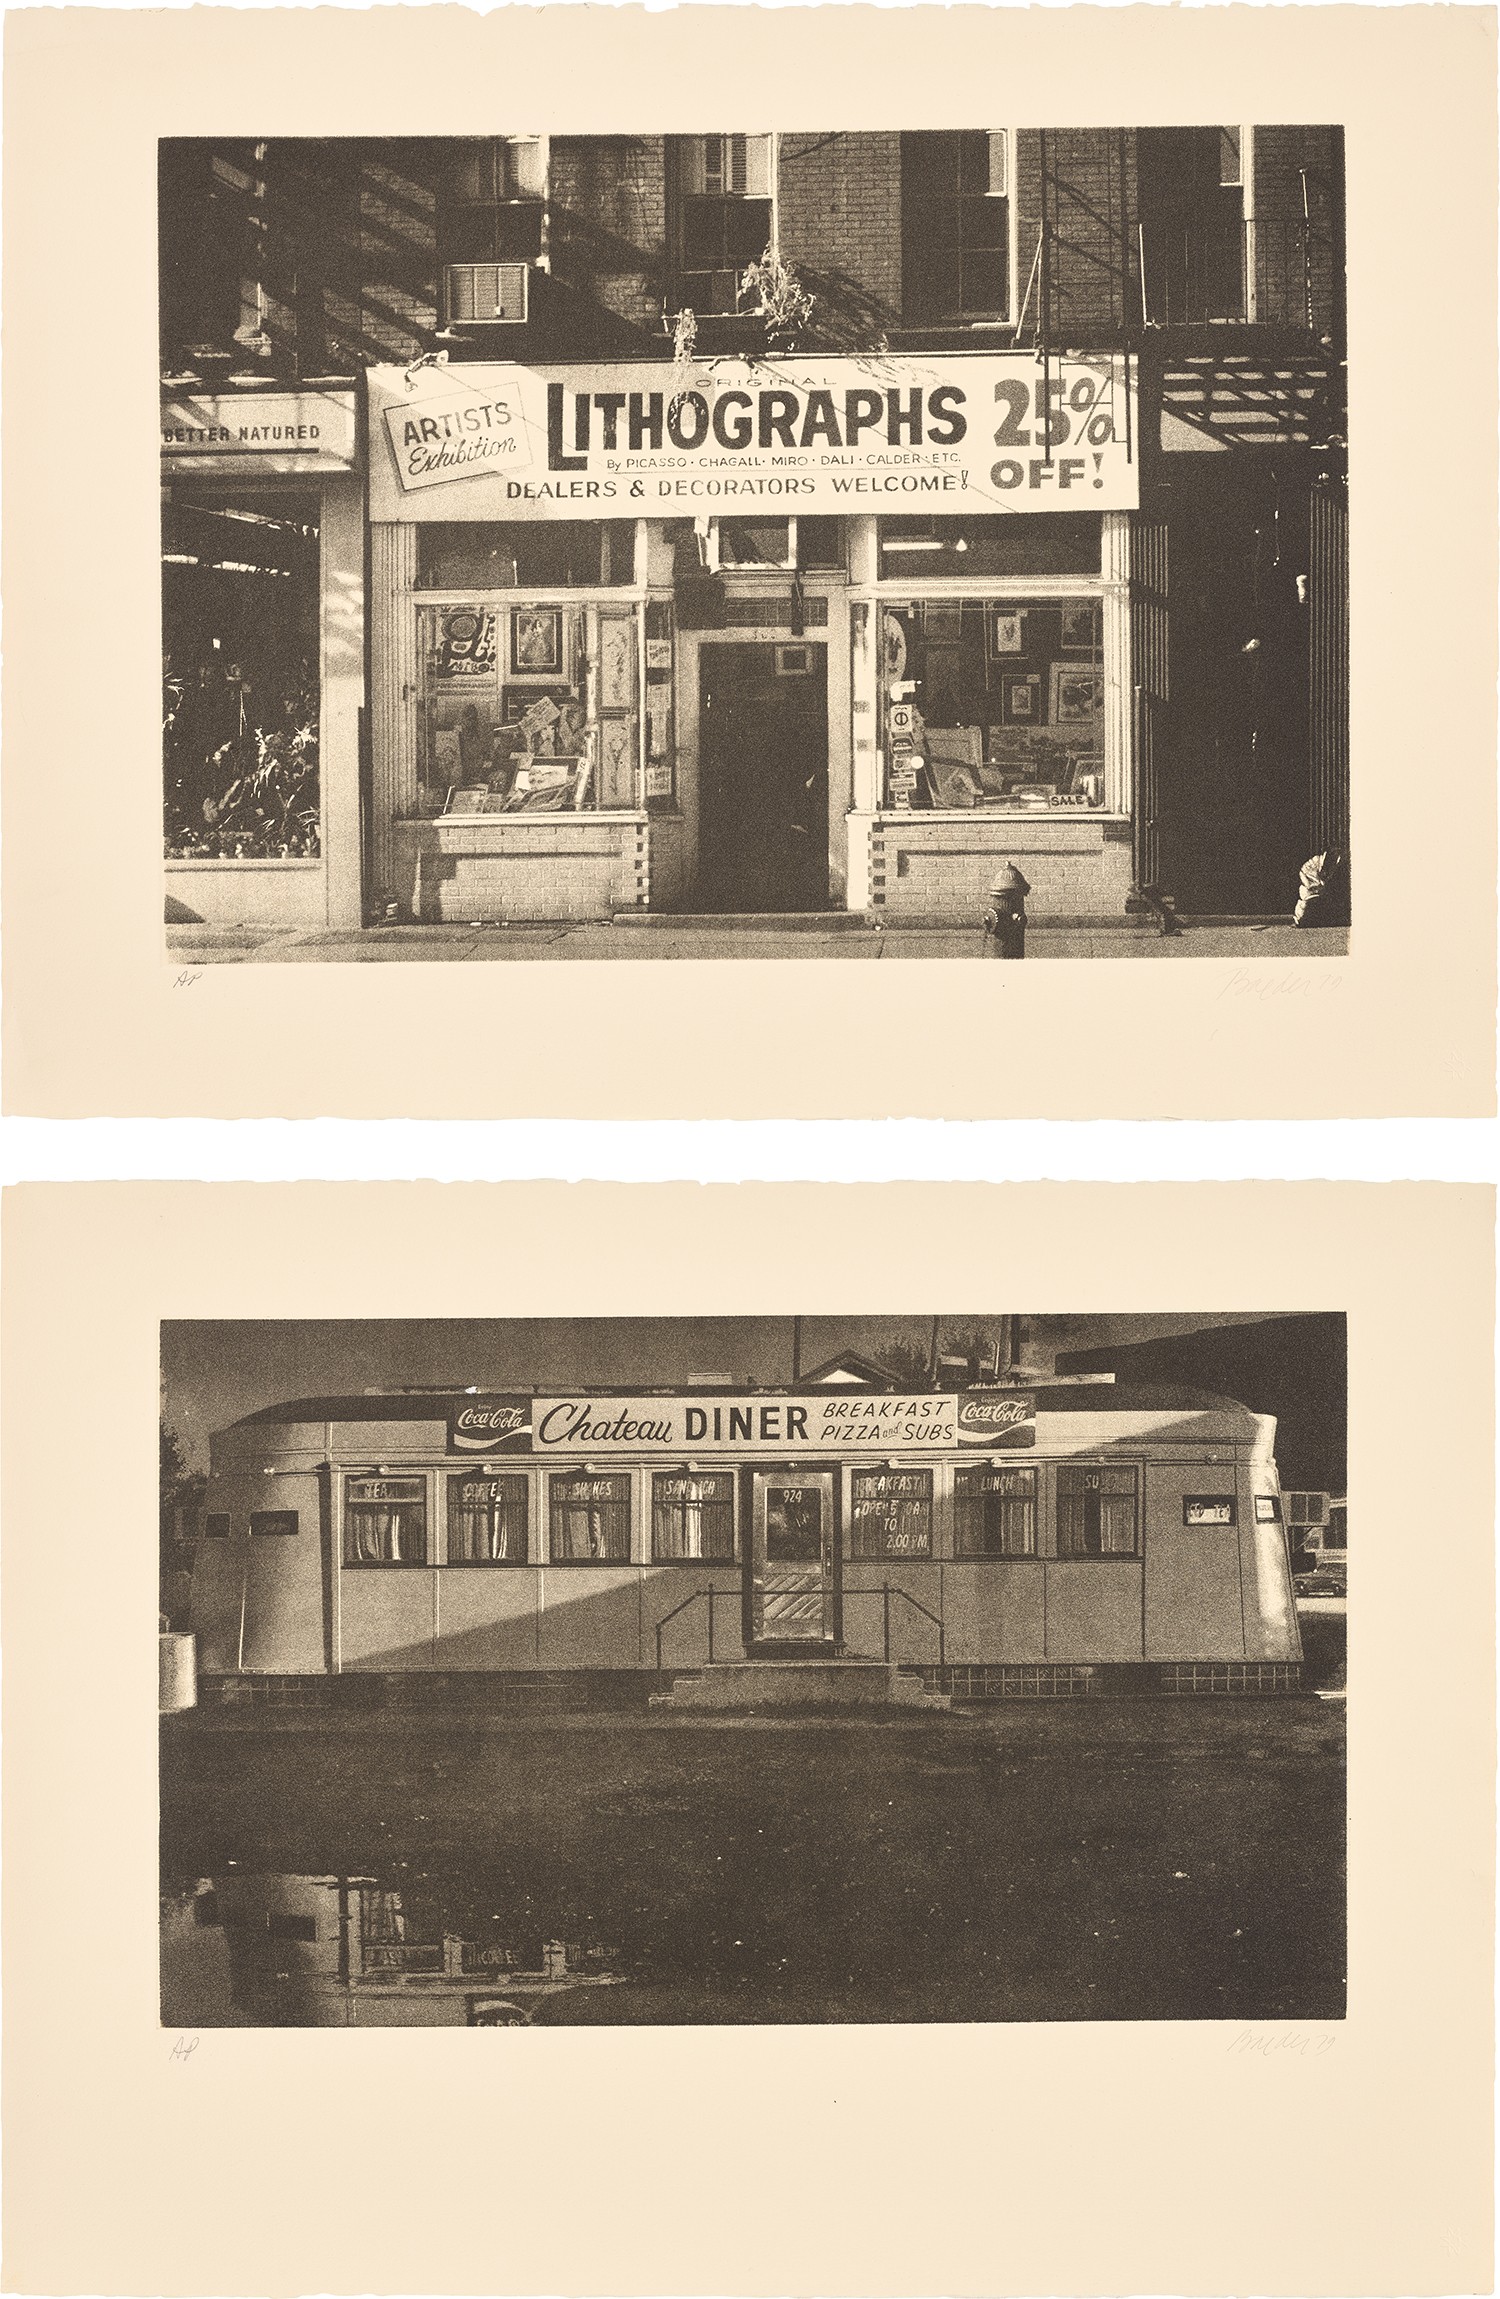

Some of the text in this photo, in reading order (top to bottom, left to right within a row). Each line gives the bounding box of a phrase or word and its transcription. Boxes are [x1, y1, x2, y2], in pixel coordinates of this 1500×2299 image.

[695, 376, 838, 388] ORIGINAL
[993, 376, 1114, 447] 25%
[163, 425, 320, 443] BETTER NATURED
[403, 402, 512, 447] ARTISTS
[547, 383, 968, 472] LITHOGRAPHS
[408, 435, 517, 476] Exhibition
[606, 452, 961, 472] By PICASSO CHAGALL MIRO DALI CALDER ETC.
[990, 452, 1105, 490] OFF!
[506, 470, 969, 499] DEALERS & DECORATORS WELCOME!
[1051, 795, 1083, 807] SALE
[457, 1407, 526, 1430] Coca-Cola
[823, 1401, 951, 1418] BREAKFAST
[960, 1400, 1029, 1423] Coca-Cola
[538, 1402, 809, 1445] Chateau DINER
[820, 1421, 954, 1441] PIZZA and SUBS
[884, 1517, 898, 1531] TO
